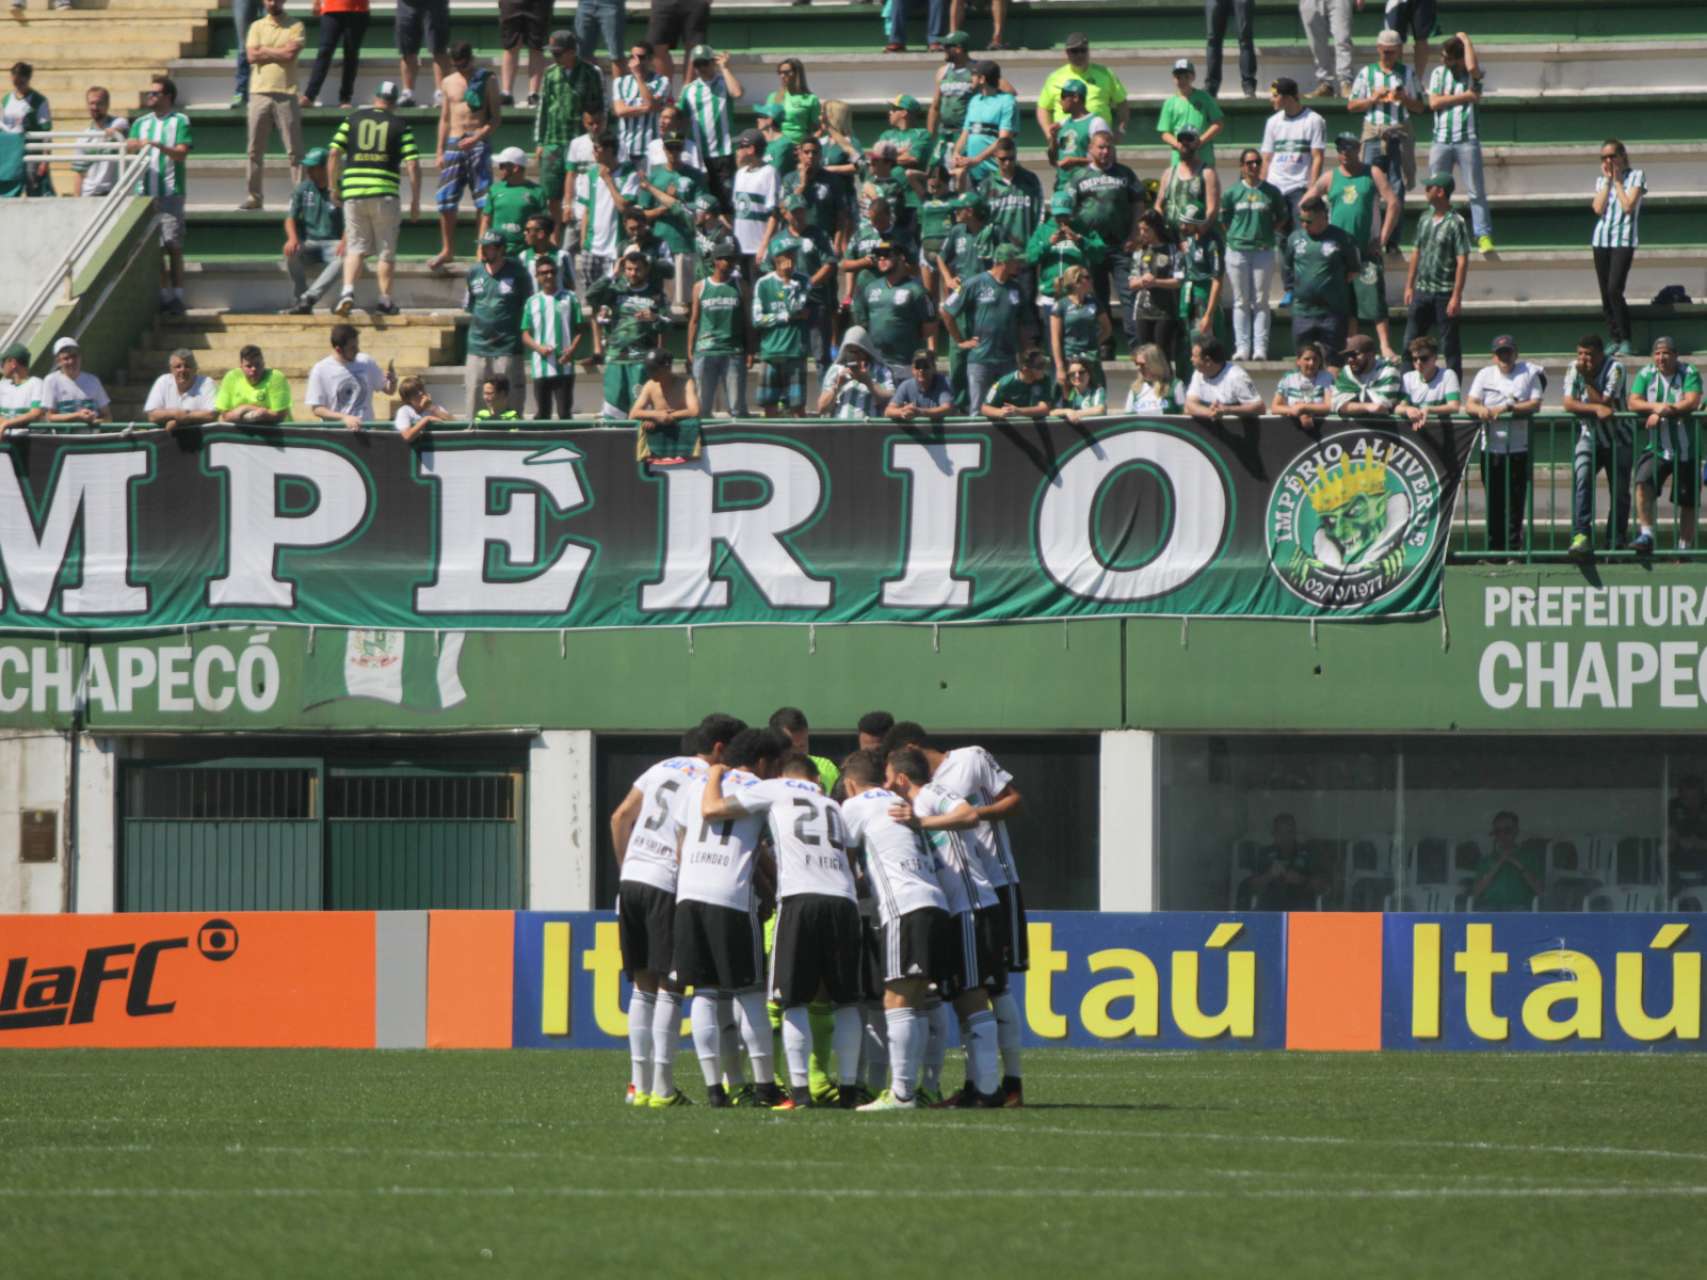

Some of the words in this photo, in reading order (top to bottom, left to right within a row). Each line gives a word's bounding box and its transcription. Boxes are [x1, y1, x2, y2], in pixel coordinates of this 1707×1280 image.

[357, 119, 389, 151] 01
[1275, 442, 1344, 543] IMPÉRIO
[0, 632, 280, 713] CHAPECÓ
[1478, 641, 1707, 709] CHAPE
[644, 780, 680, 832] 5
[793, 797, 844, 852] 20
[690, 851, 730, 867] LEANDRO
[1023, 922, 1256, 1040] taú
[1411, 922, 1702, 1041] Itaú
